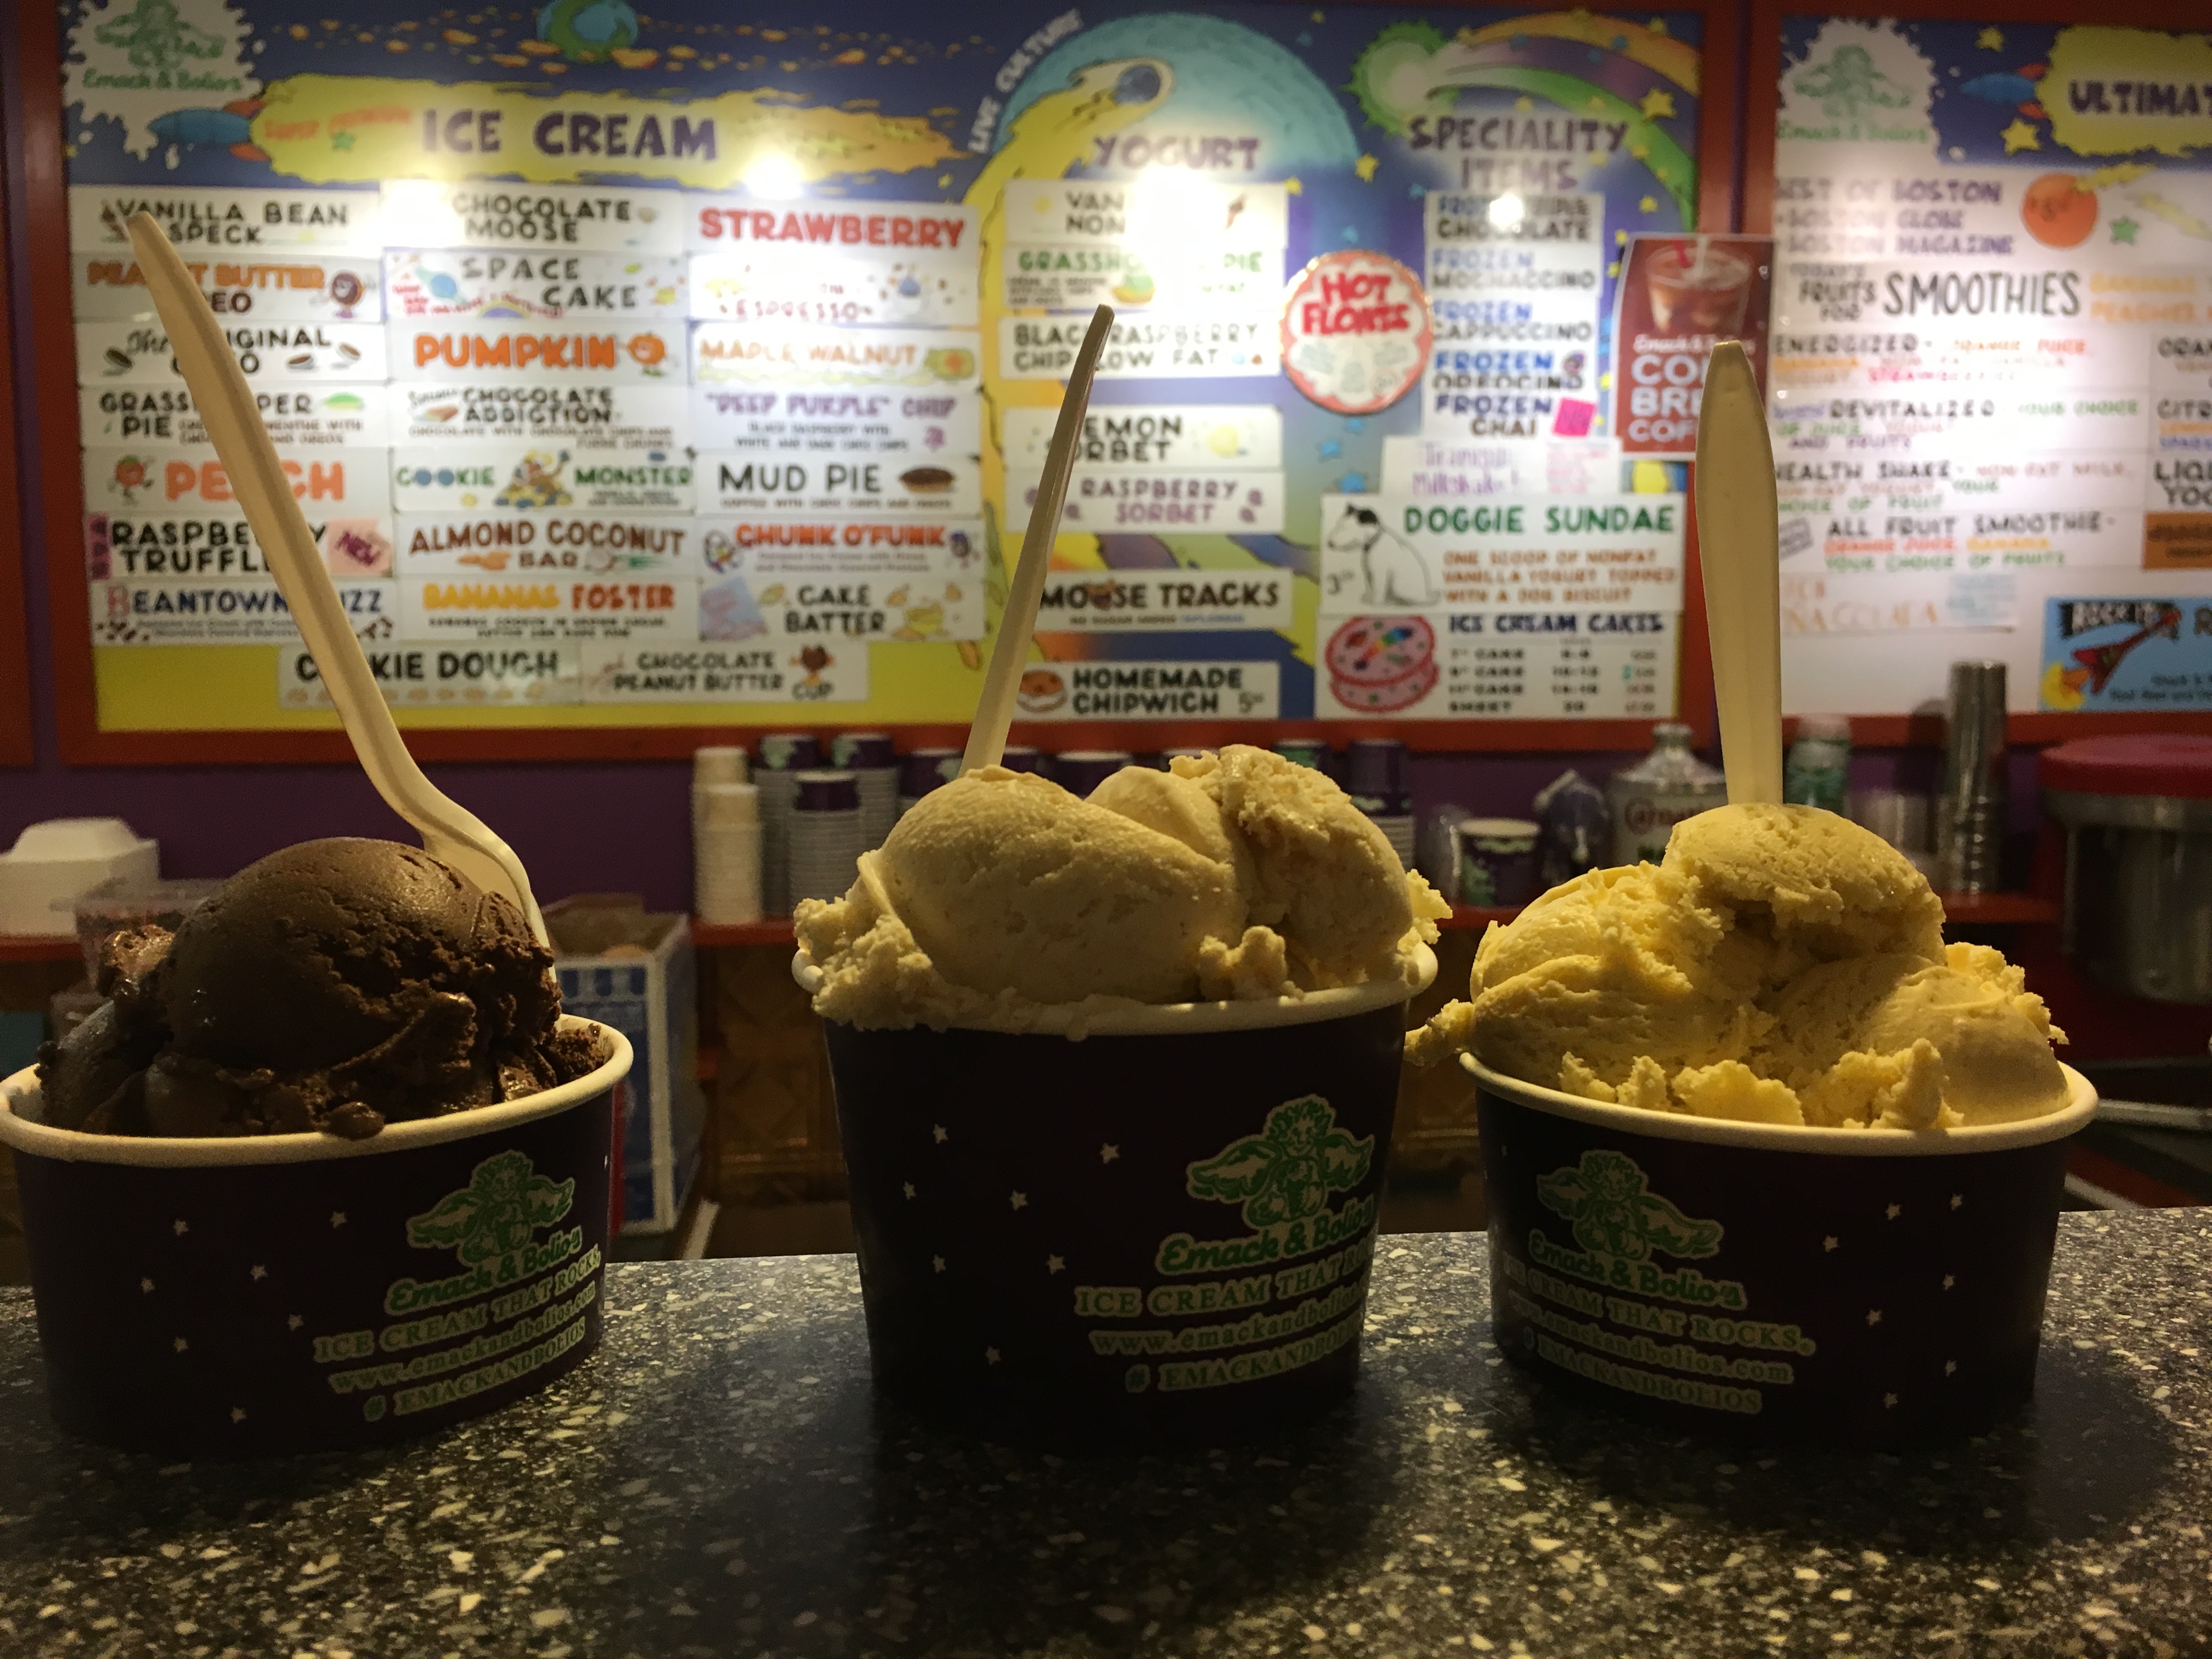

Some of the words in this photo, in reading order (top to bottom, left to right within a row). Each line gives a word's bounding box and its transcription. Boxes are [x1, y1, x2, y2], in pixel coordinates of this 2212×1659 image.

[422, 109, 501, 154] ICE
[533, 111, 718, 160] CREAM
[1410, 115, 1628, 151] SPECIALITY
[1094, 136, 1260, 170] YOGURT
[1462, 157, 1578, 189] ITEMS
[116, 198, 244, 223] VANILLA
[264, 200, 349, 226] BEAN
[453, 191, 631, 222] CHOCOLATE
[168, 223, 263, 245] SPECK
[465, 218, 579, 243] MOOSE
[700, 207, 966, 249] STRAWBERRY
[461, 257, 580, 281] SPACE
[1432, 248, 1536, 269] FROZEN
[540, 284, 638, 309] CAKE
[1321, 273, 1392, 303] HOT
[1883, 270, 2081, 317] SMOOTHIES
[414, 333, 617, 369] PUMPKIN
[701, 340, 794, 362] MAPLE
[809, 343, 917, 366] WALNUT
[1013, 349, 1073, 373] CHIP
[1172, 348, 1219, 366] FAT
[1435, 350, 1553, 372] FROZEN
[462, 386, 614, 405] CHOCOLATE
[1435, 393, 1553, 415] FROZEN
[122, 415, 172, 438] PIE
[464, 407, 611, 424] ADDICTION
[1084, 415, 1183, 438] EMON
[1470, 419, 1537, 437] CHAI
[165, 459, 345, 502] PECH
[574, 466, 691, 486] MONSTER
[719, 464, 808, 493] MUD
[826, 464, 882, 493] PIE
[1080, 478, 1238, 499] RASPBERRY
[1115, 503, 1212, 524] SORBET
[1403, 505, 1525, 534] DOGGIE
[1544, 504, 1675, 534] SUNDAE
[111, 520, 326, 546] RASPBEY
[408, 520, 535, 556] ALMOND
[547, 520, 686, 556] COCONUT
[736, 524, 837, 546] CHUNK
[1828, 520, 1868, 538] ALL
[1885, 515, 1959, 536] FRUIT
[518, 551, 579, 568] BAR
[571, 583, 675, 610] FOSTER
[797, 584, 872, 607] CAKE
[1160, 582, 1280, 607] TRACKS
[785, 611, 885, 634] BATTER
[1449, 614, 1483, 633] ICE
[1494, 614, 1577, 634] CREAM
[1588, 612, 1664, 634] CAKES
[437, 650, 560, 680] DOUGH
[636, 651, 774, 671] CHOCOLATE
[613, 673, 697, 692] PEANUT
[703, 672, 785, 692] BUTTER
[1072, 667, 1244, 690] HOMEMADE
[1072, 691, 1219, 714] CHIPWICH
[1159, 1229, 1280, 1273] Emack
[1284, 1222, 1307, 1256] &
[1531, 1231, 1606, 1283] Emack
[1609, 1260, 1634, 1289] &
[388, 1267, 493, 1311] Emack
[498, 1254, 517, 1285] &
[1079, 1290, 1138, 1314] ICE
[1150, 1277, 1269, 1312] CREAM
[1278, 1253, 1339, 1296] THAT
[317, 1333, 373, 1361] ICE
[382, 1304, 488, 1350] CREAM
[493, 1279, 551, 1321] THAT
[1607, 1297, 1686, 1336] THAT
